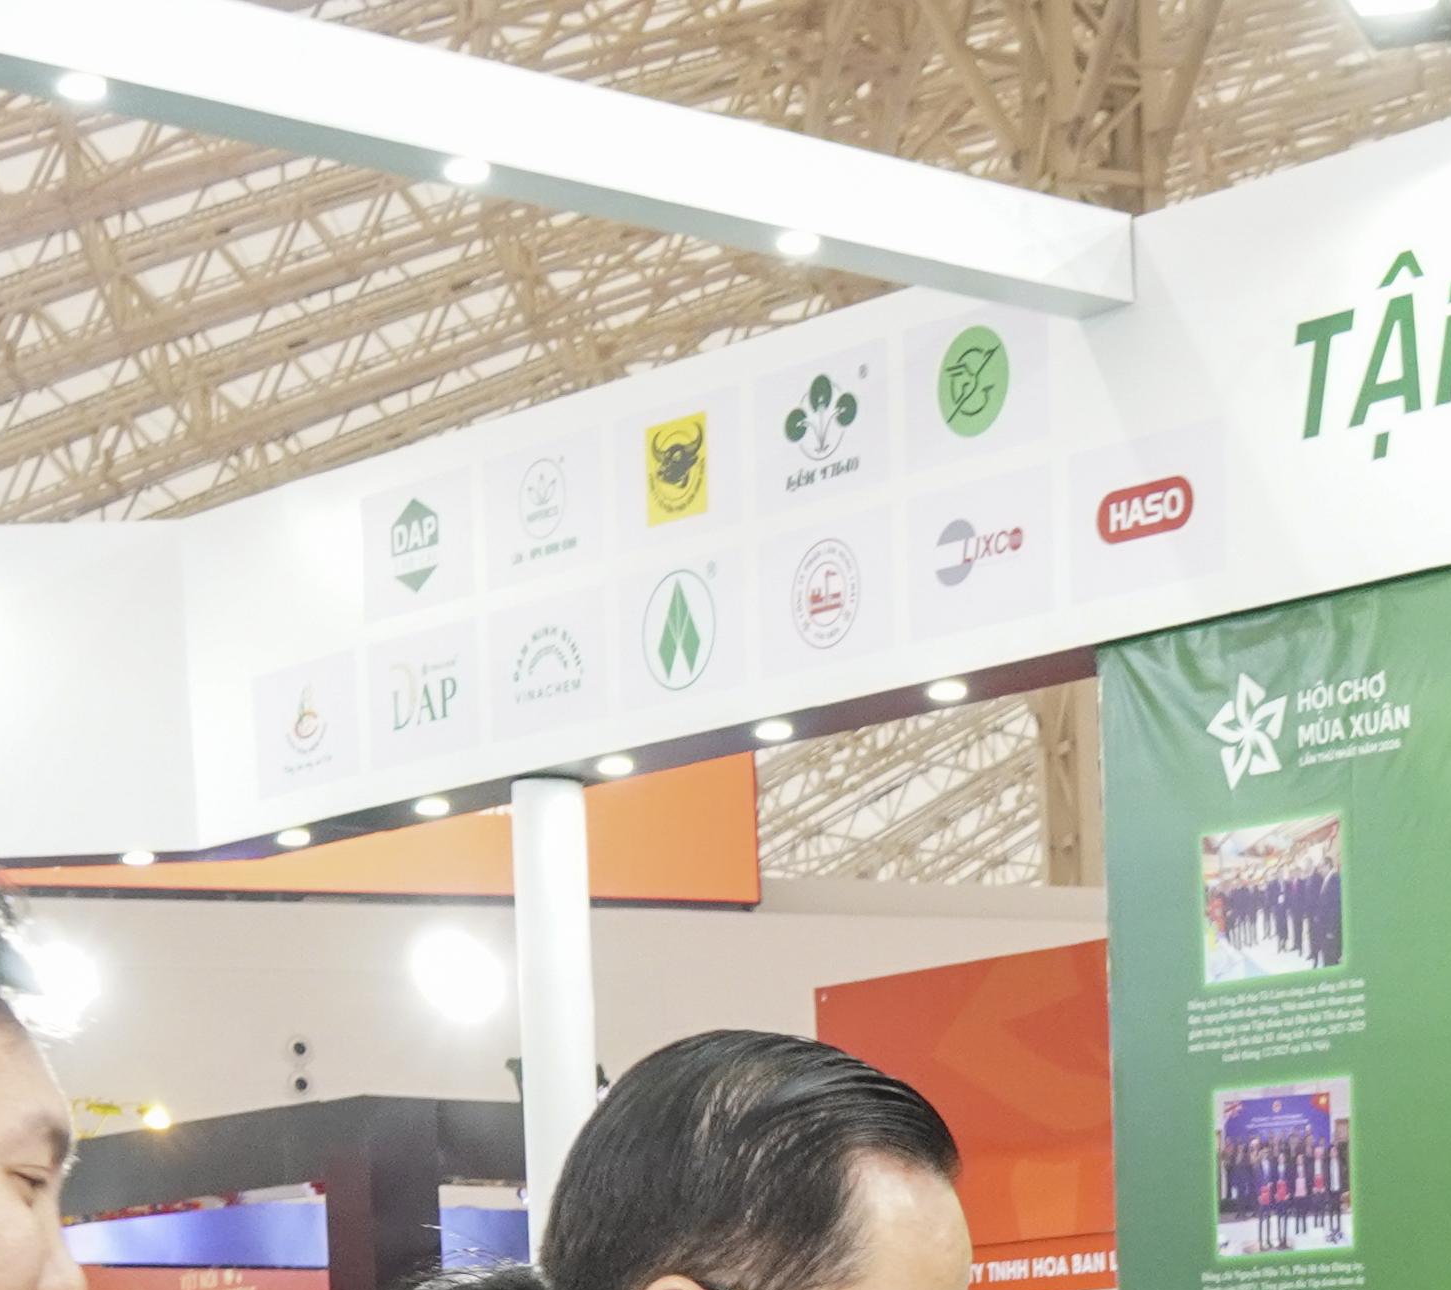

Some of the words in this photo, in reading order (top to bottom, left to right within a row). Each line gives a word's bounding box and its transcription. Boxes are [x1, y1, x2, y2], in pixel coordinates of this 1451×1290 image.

[1108, 488, 1184, 533] HASO
[392, 514, 438, 556] DAP
[962, 526, 1023, 565] LIXCO
[392, 675, 458, 731] DAP
[514, 678, 582, 704] VINACHEM
[1297, 680, 1334, 714] HỘI
[1337, 670, 1386, 703] CHỢ
[1298, 716, 1346, 748] MÙA
[1349, 702, 1410, 739] XUÂN
[987, 1260, 1029, 1282] TNHH
[1032, 1257, 1068, 1278] HOA
[1071, 1251, 1106, 1275] BAN
